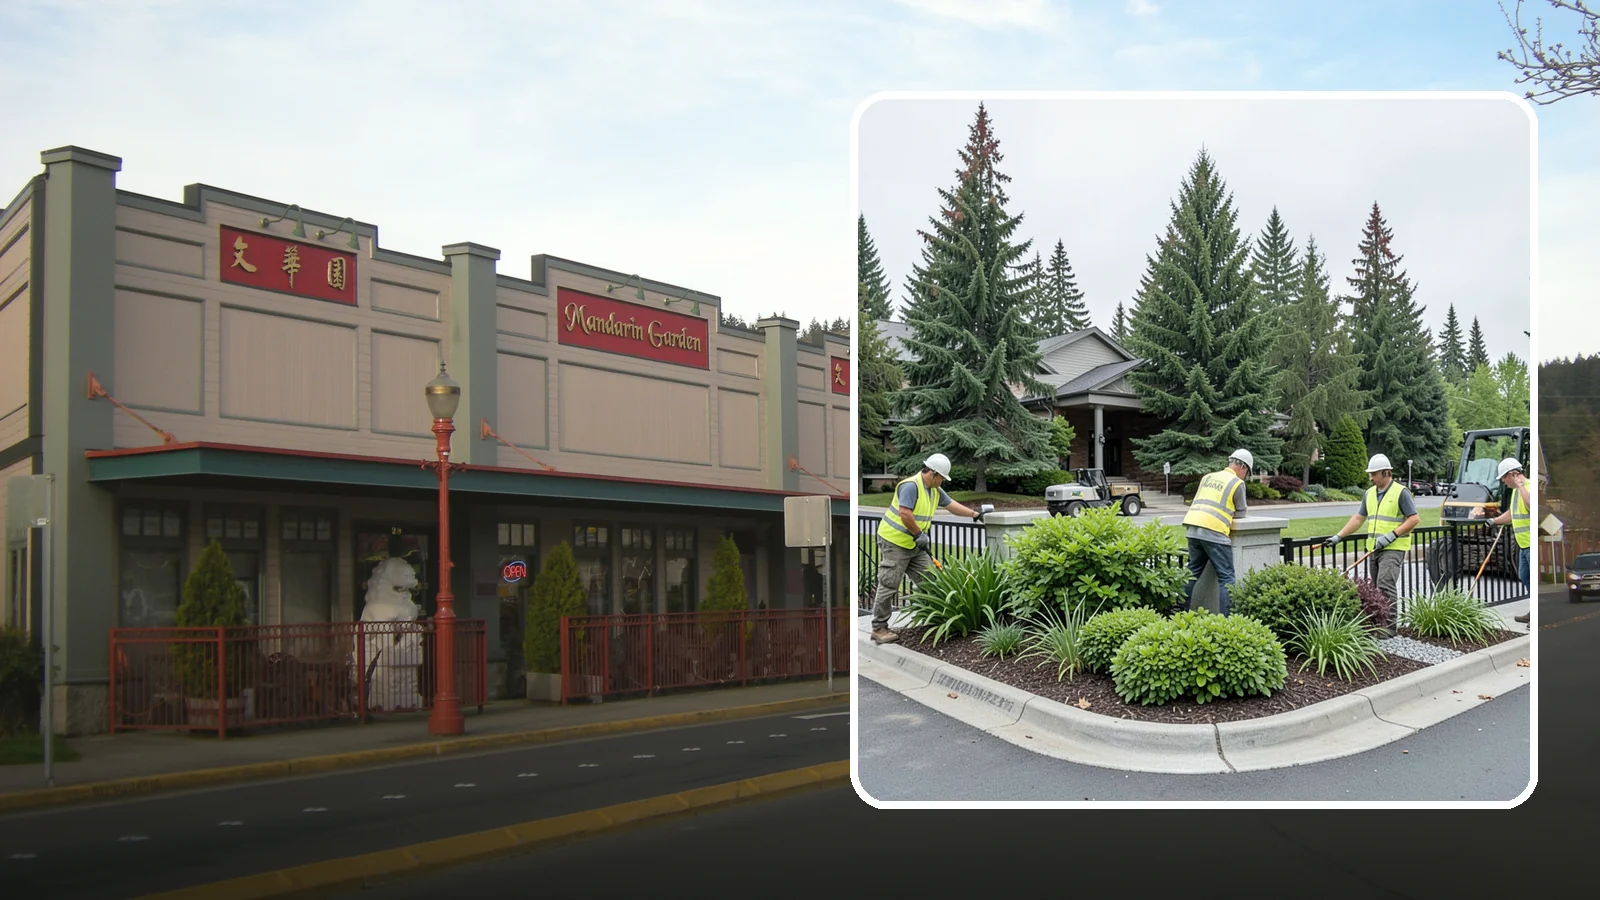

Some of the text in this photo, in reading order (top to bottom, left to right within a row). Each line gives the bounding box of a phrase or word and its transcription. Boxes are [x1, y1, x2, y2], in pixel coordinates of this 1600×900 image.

[231, 236, 346, 290] 文華園
[565, 302, 701, 351] Mandarin Garden
[503, 565, 527, 578] OPEN
